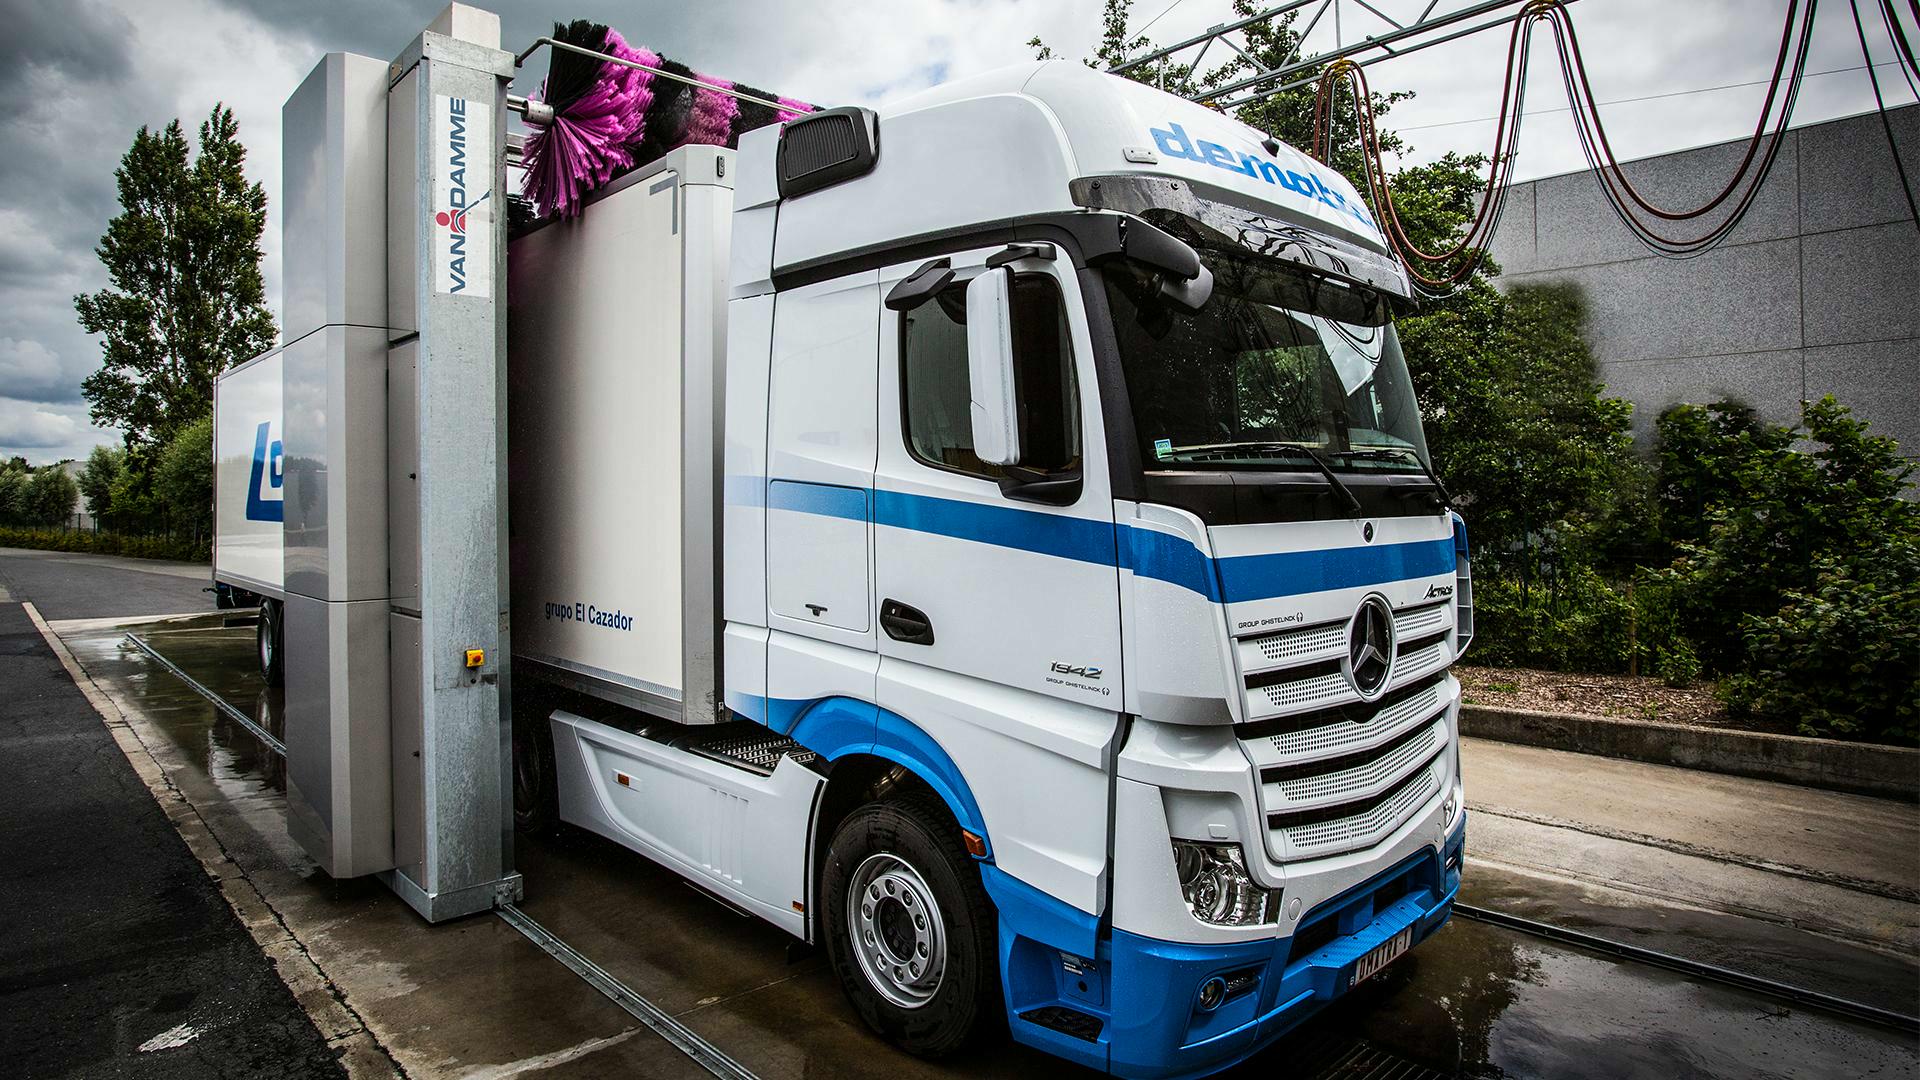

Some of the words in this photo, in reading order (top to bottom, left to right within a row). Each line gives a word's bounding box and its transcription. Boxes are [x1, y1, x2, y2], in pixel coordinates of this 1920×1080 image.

[545, 602, 573, 622] grupo
[575, 602, 585, 622] El
[588, 605, 633, 631] Cazador
[1238, 620, 1260, 629] GROUP
[1050, 661, 1103, 680] 1942
[1045, 677, 1065, 685] GROUP
